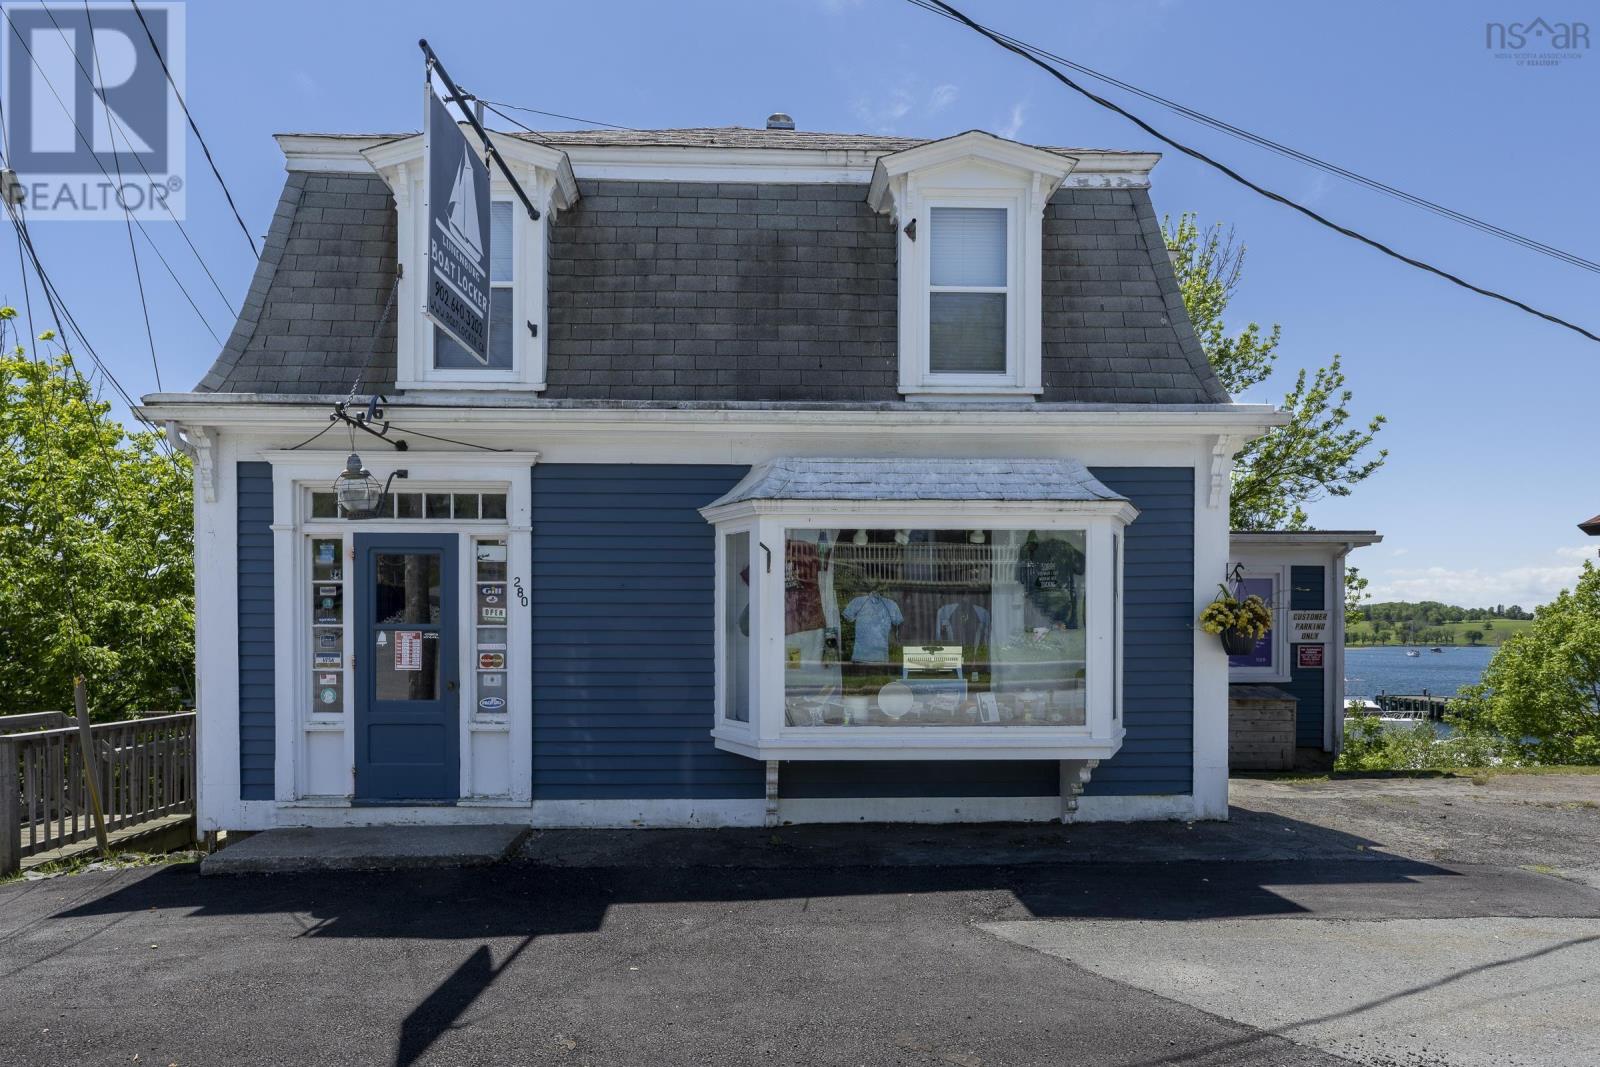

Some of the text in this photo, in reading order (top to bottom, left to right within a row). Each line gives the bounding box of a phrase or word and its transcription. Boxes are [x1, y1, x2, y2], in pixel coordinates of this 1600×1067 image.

[431, 238, 488, 313] BOAT LOCKER
[442, 235, 480, 283] LUNENBURG
[513, 577, 528, 607] 280
[1293, 613, 1328, 621] CUSTOMER
